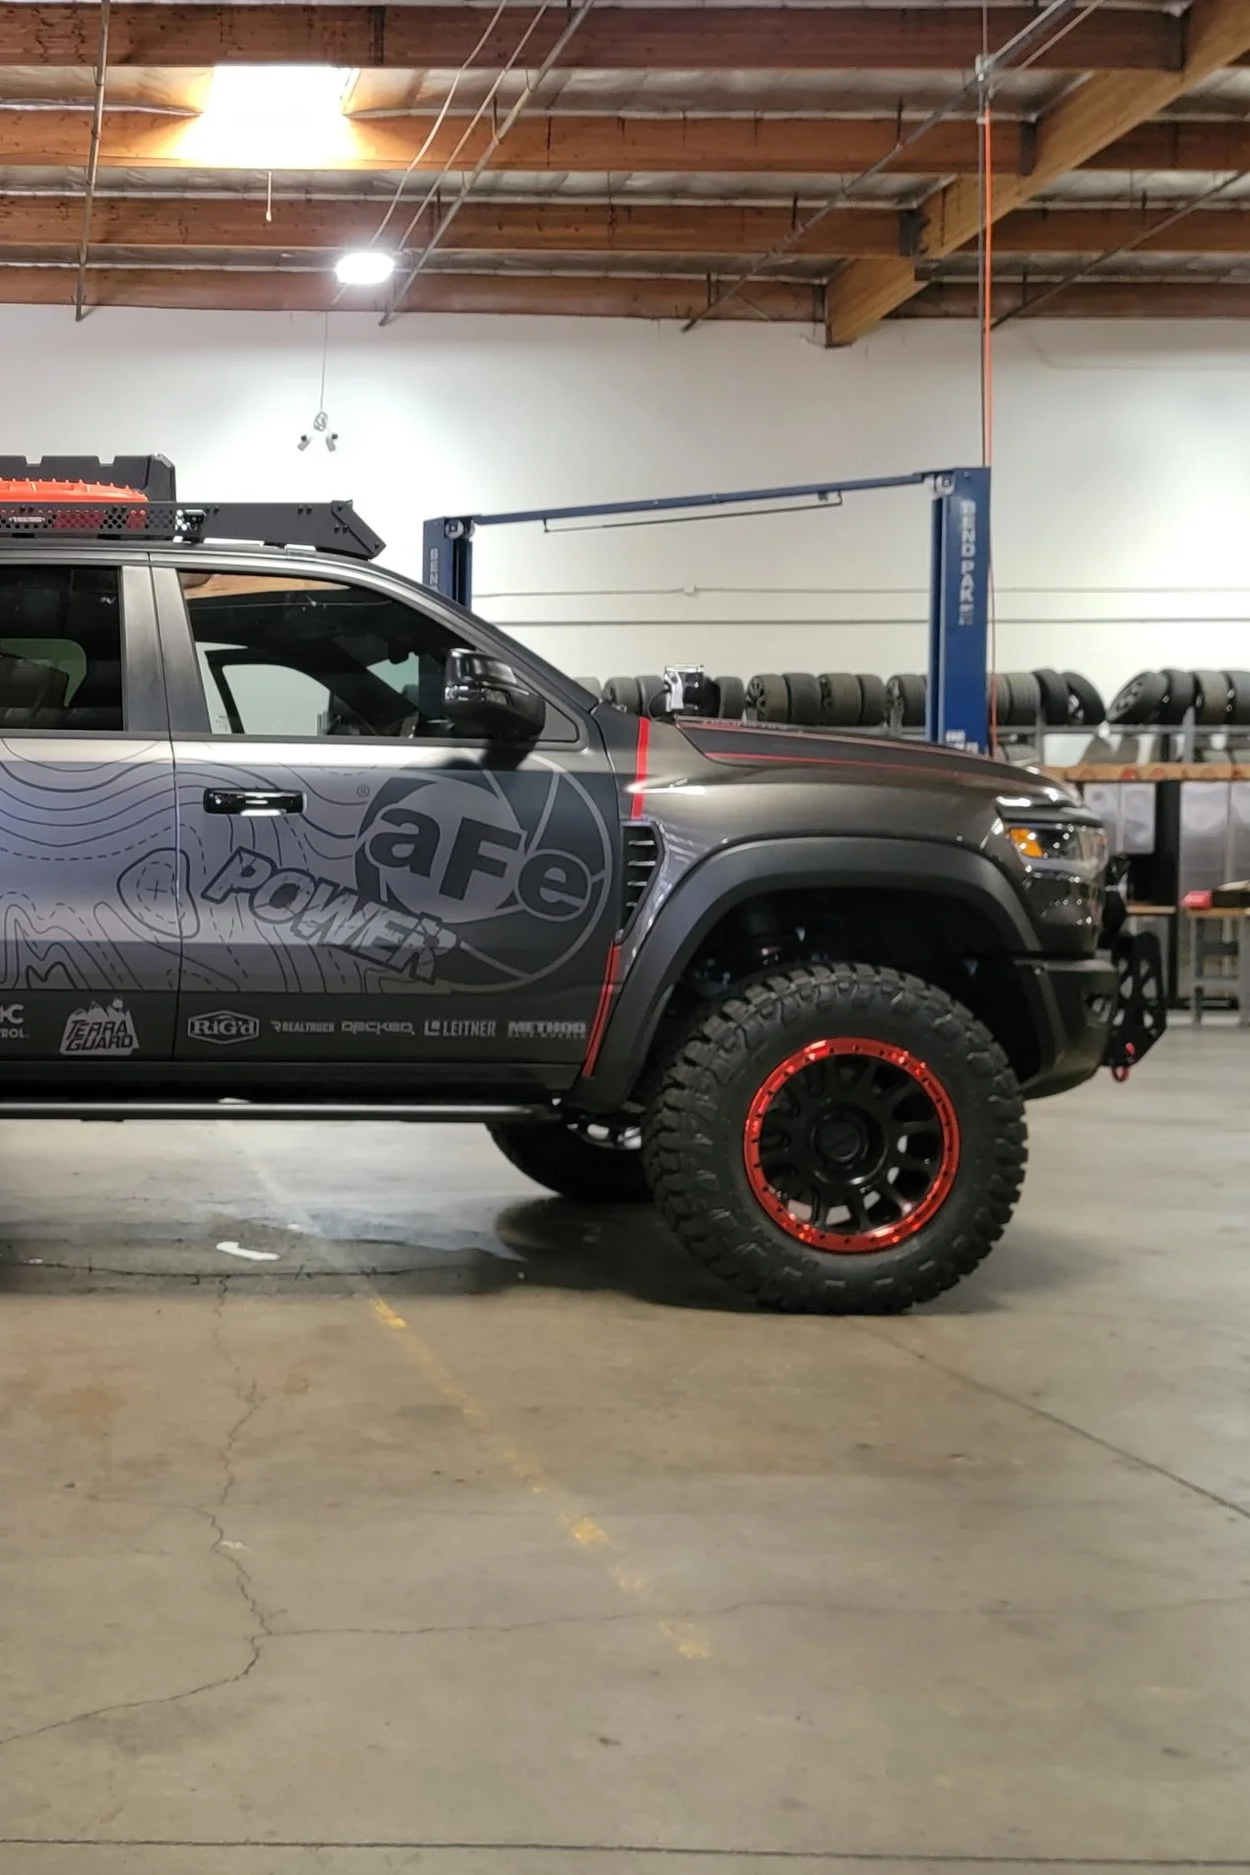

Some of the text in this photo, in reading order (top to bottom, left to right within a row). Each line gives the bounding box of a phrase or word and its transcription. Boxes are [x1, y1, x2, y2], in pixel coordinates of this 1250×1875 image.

[368, 806, 590, 917] aFe
[201, 846, 458, 985] POWER
[67, 1020, 129, 1041] TERRA
[443, 1020, 498, 1037] LEITNER
[65, 1035, 134, 1051] GUARD
